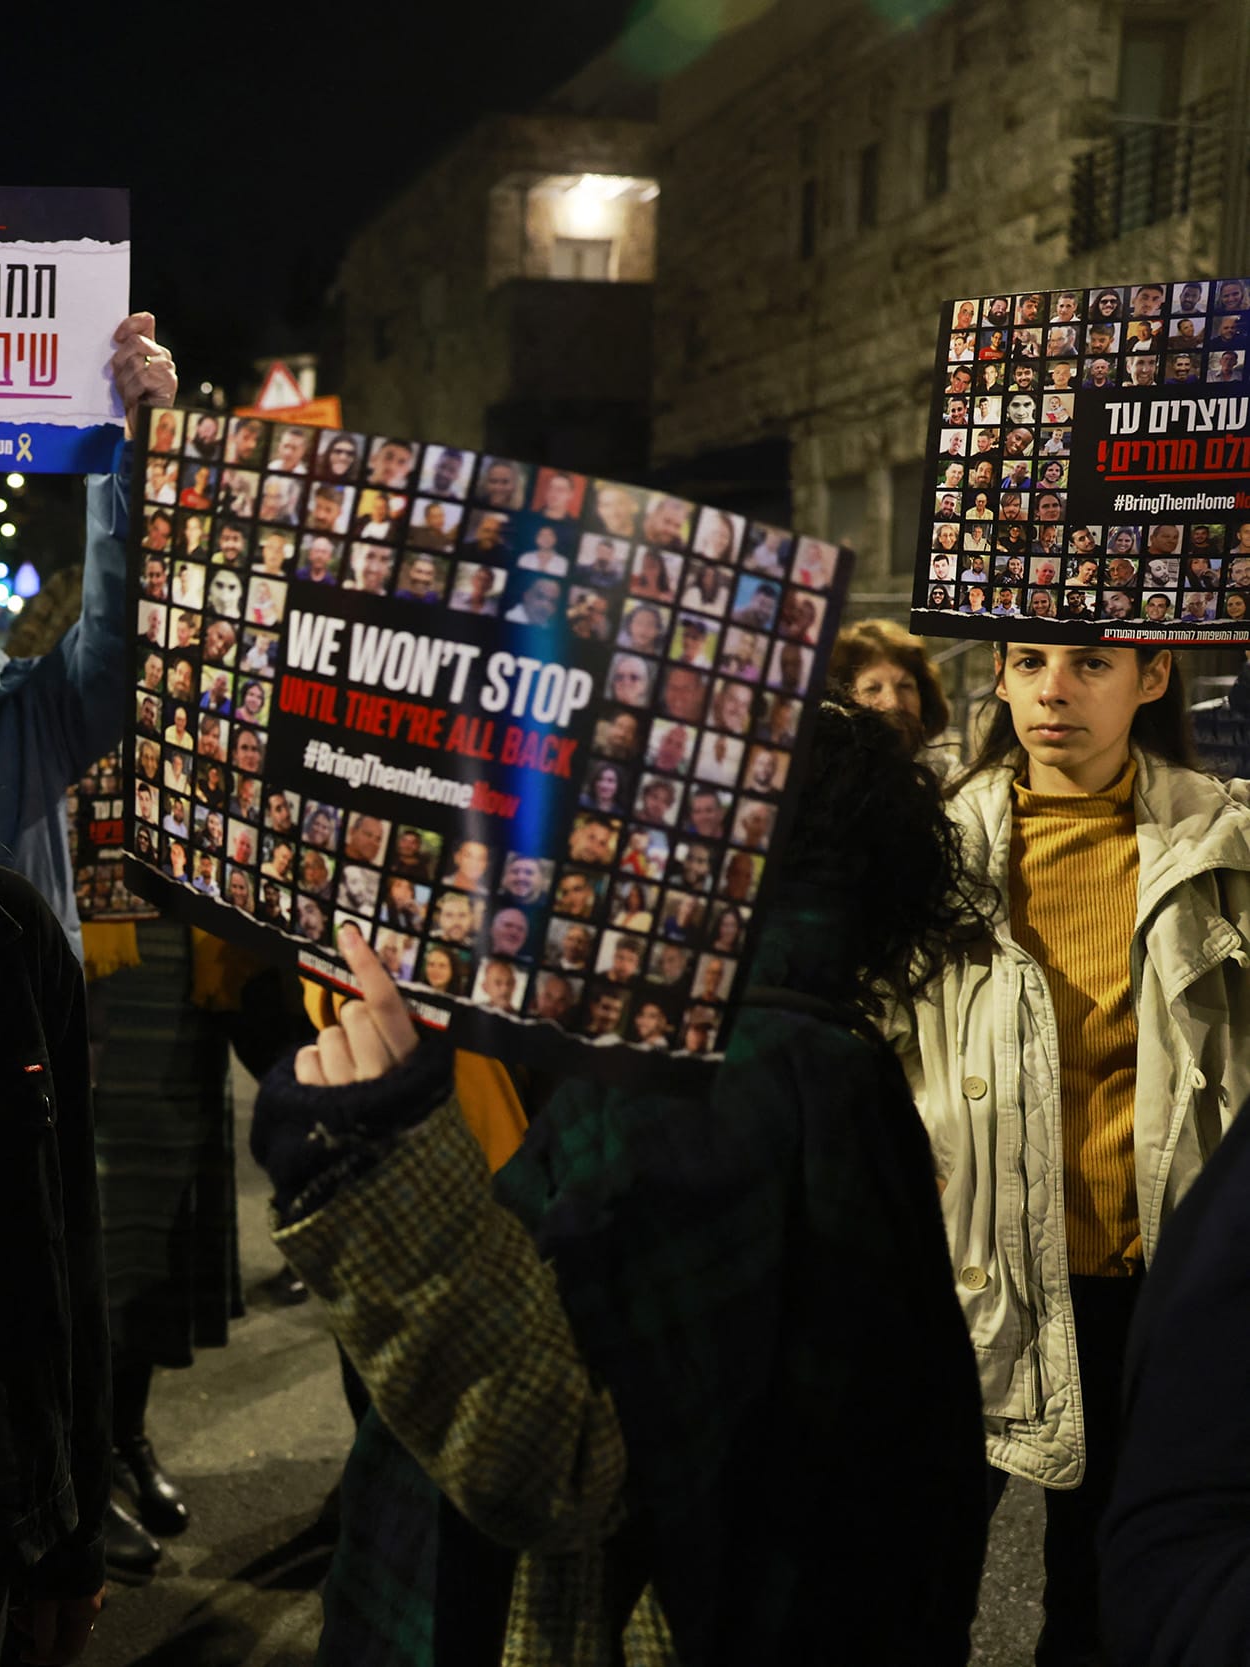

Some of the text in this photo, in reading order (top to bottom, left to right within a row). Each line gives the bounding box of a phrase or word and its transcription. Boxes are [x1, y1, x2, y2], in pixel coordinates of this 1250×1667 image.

[1104, 396, 1249, 435] עוצרים עד
[1096, 439, 1198, 473] חוזרים!
[286, 609, 593, 728] WE WON'T STOP
[279, 675, 578, 778] UNTIL THEY'RE ALL BACK
[303, 739, 521, 819] #BringThemHomeNow
